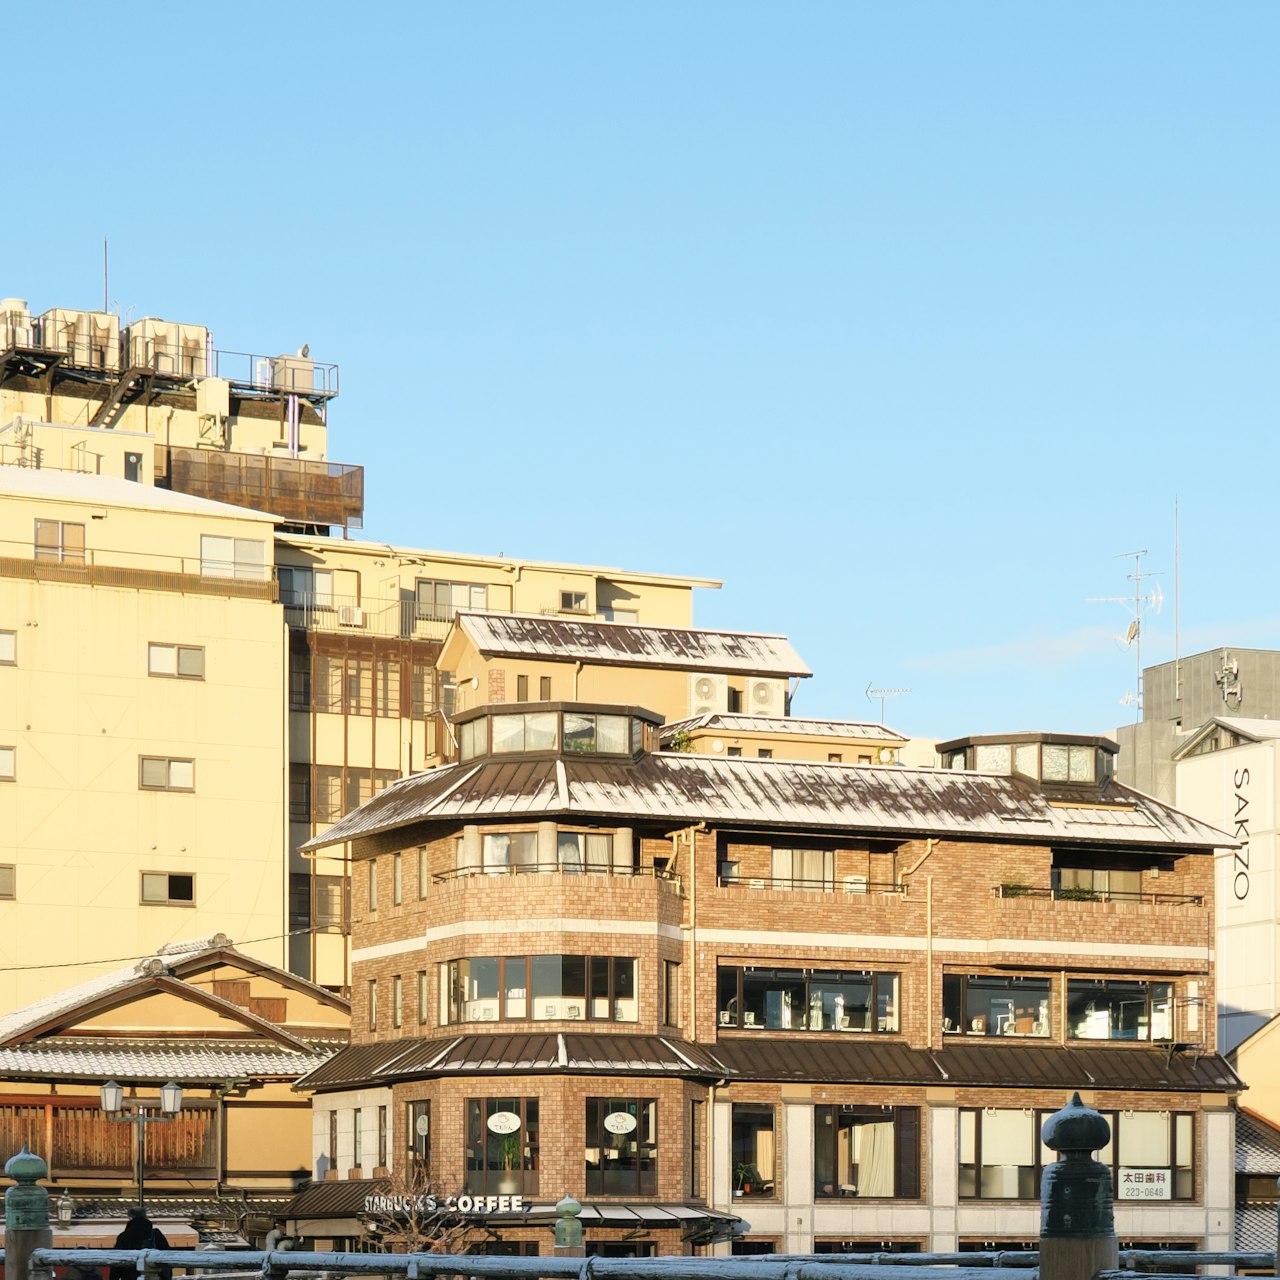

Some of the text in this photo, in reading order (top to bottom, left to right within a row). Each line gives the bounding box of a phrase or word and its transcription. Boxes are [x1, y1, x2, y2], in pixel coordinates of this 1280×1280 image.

[1233, 767, 1250, 900] SAKIZO
[1123, 1172, 1166, 1183] 太田歯科
[1125, 1187, 1164, 1197] 223-0648
[444, 1195, 523, 1212] COFFEE
